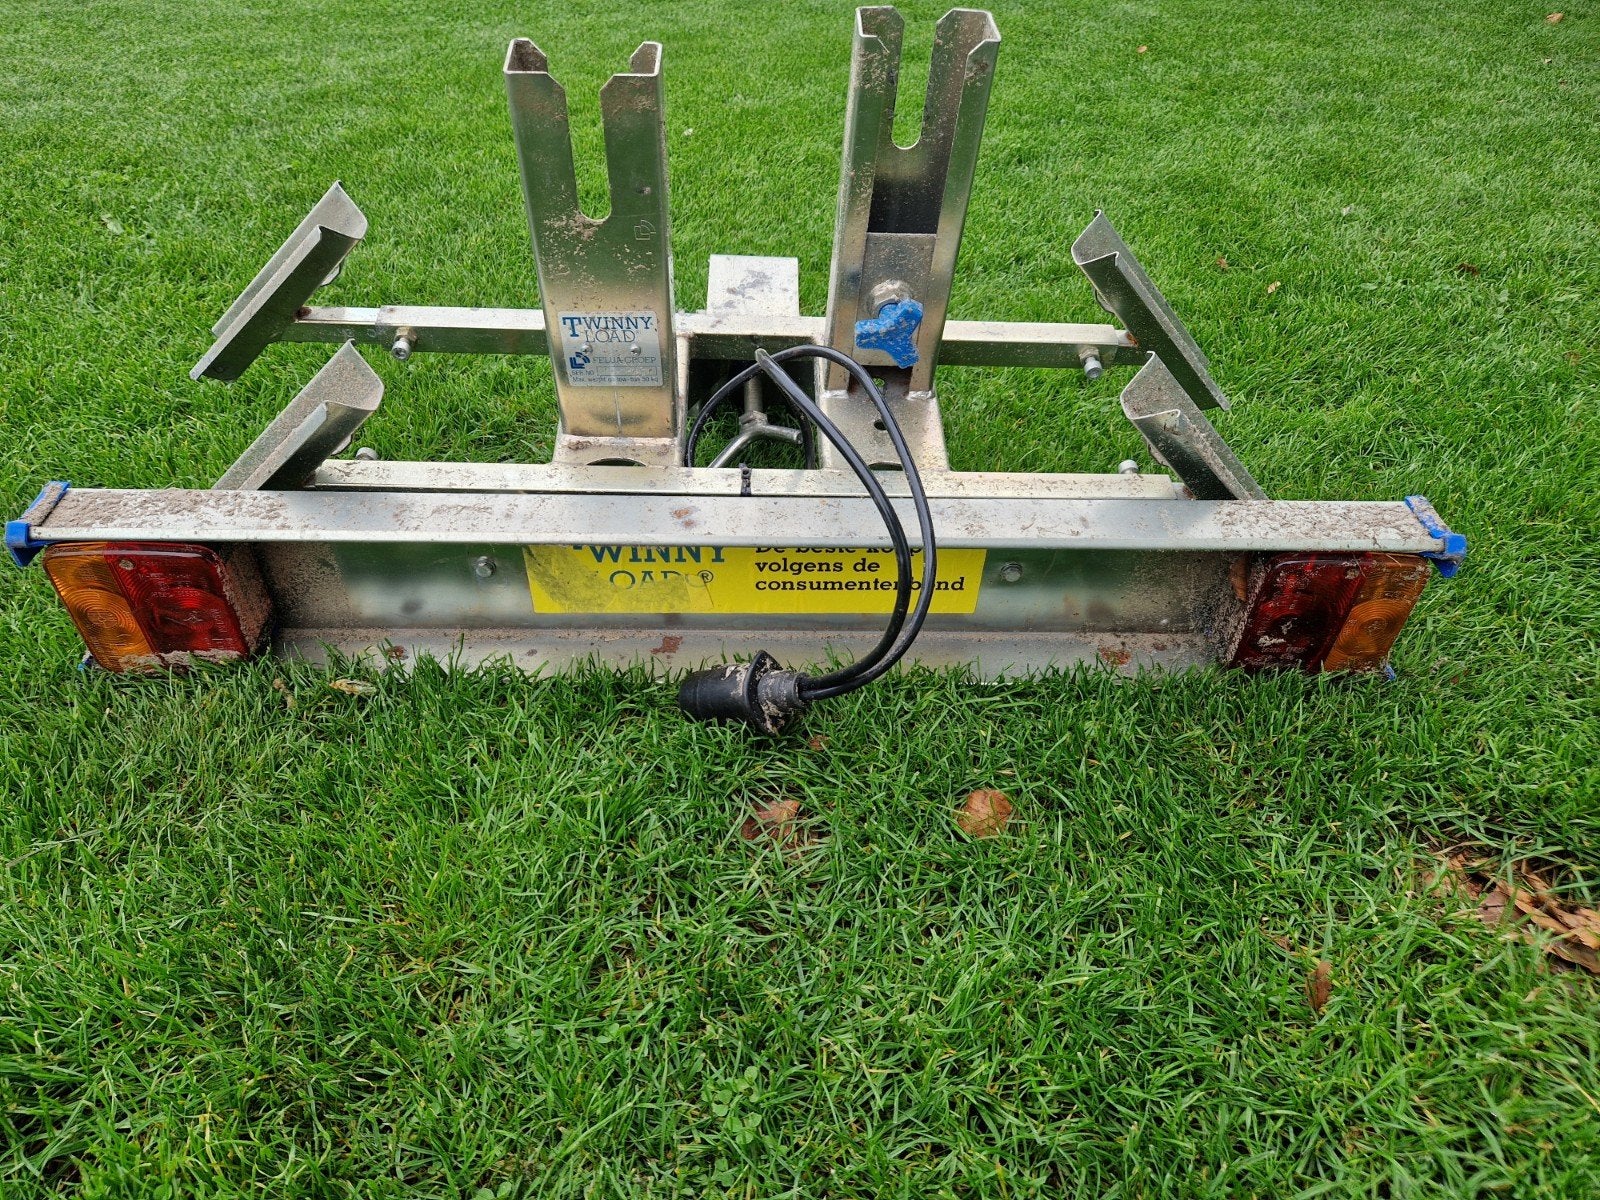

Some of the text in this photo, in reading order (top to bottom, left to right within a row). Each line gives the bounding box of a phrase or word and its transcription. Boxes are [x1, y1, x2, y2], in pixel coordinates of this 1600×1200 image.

[562, 316, 652, 337] TWINNY
[584, 329, 636, 343] LOAD
[573, 544, 725, 563] WINNY
[755, 558, 880, 575] volgens de
[755, 577, 964, 590] consumentebnd
